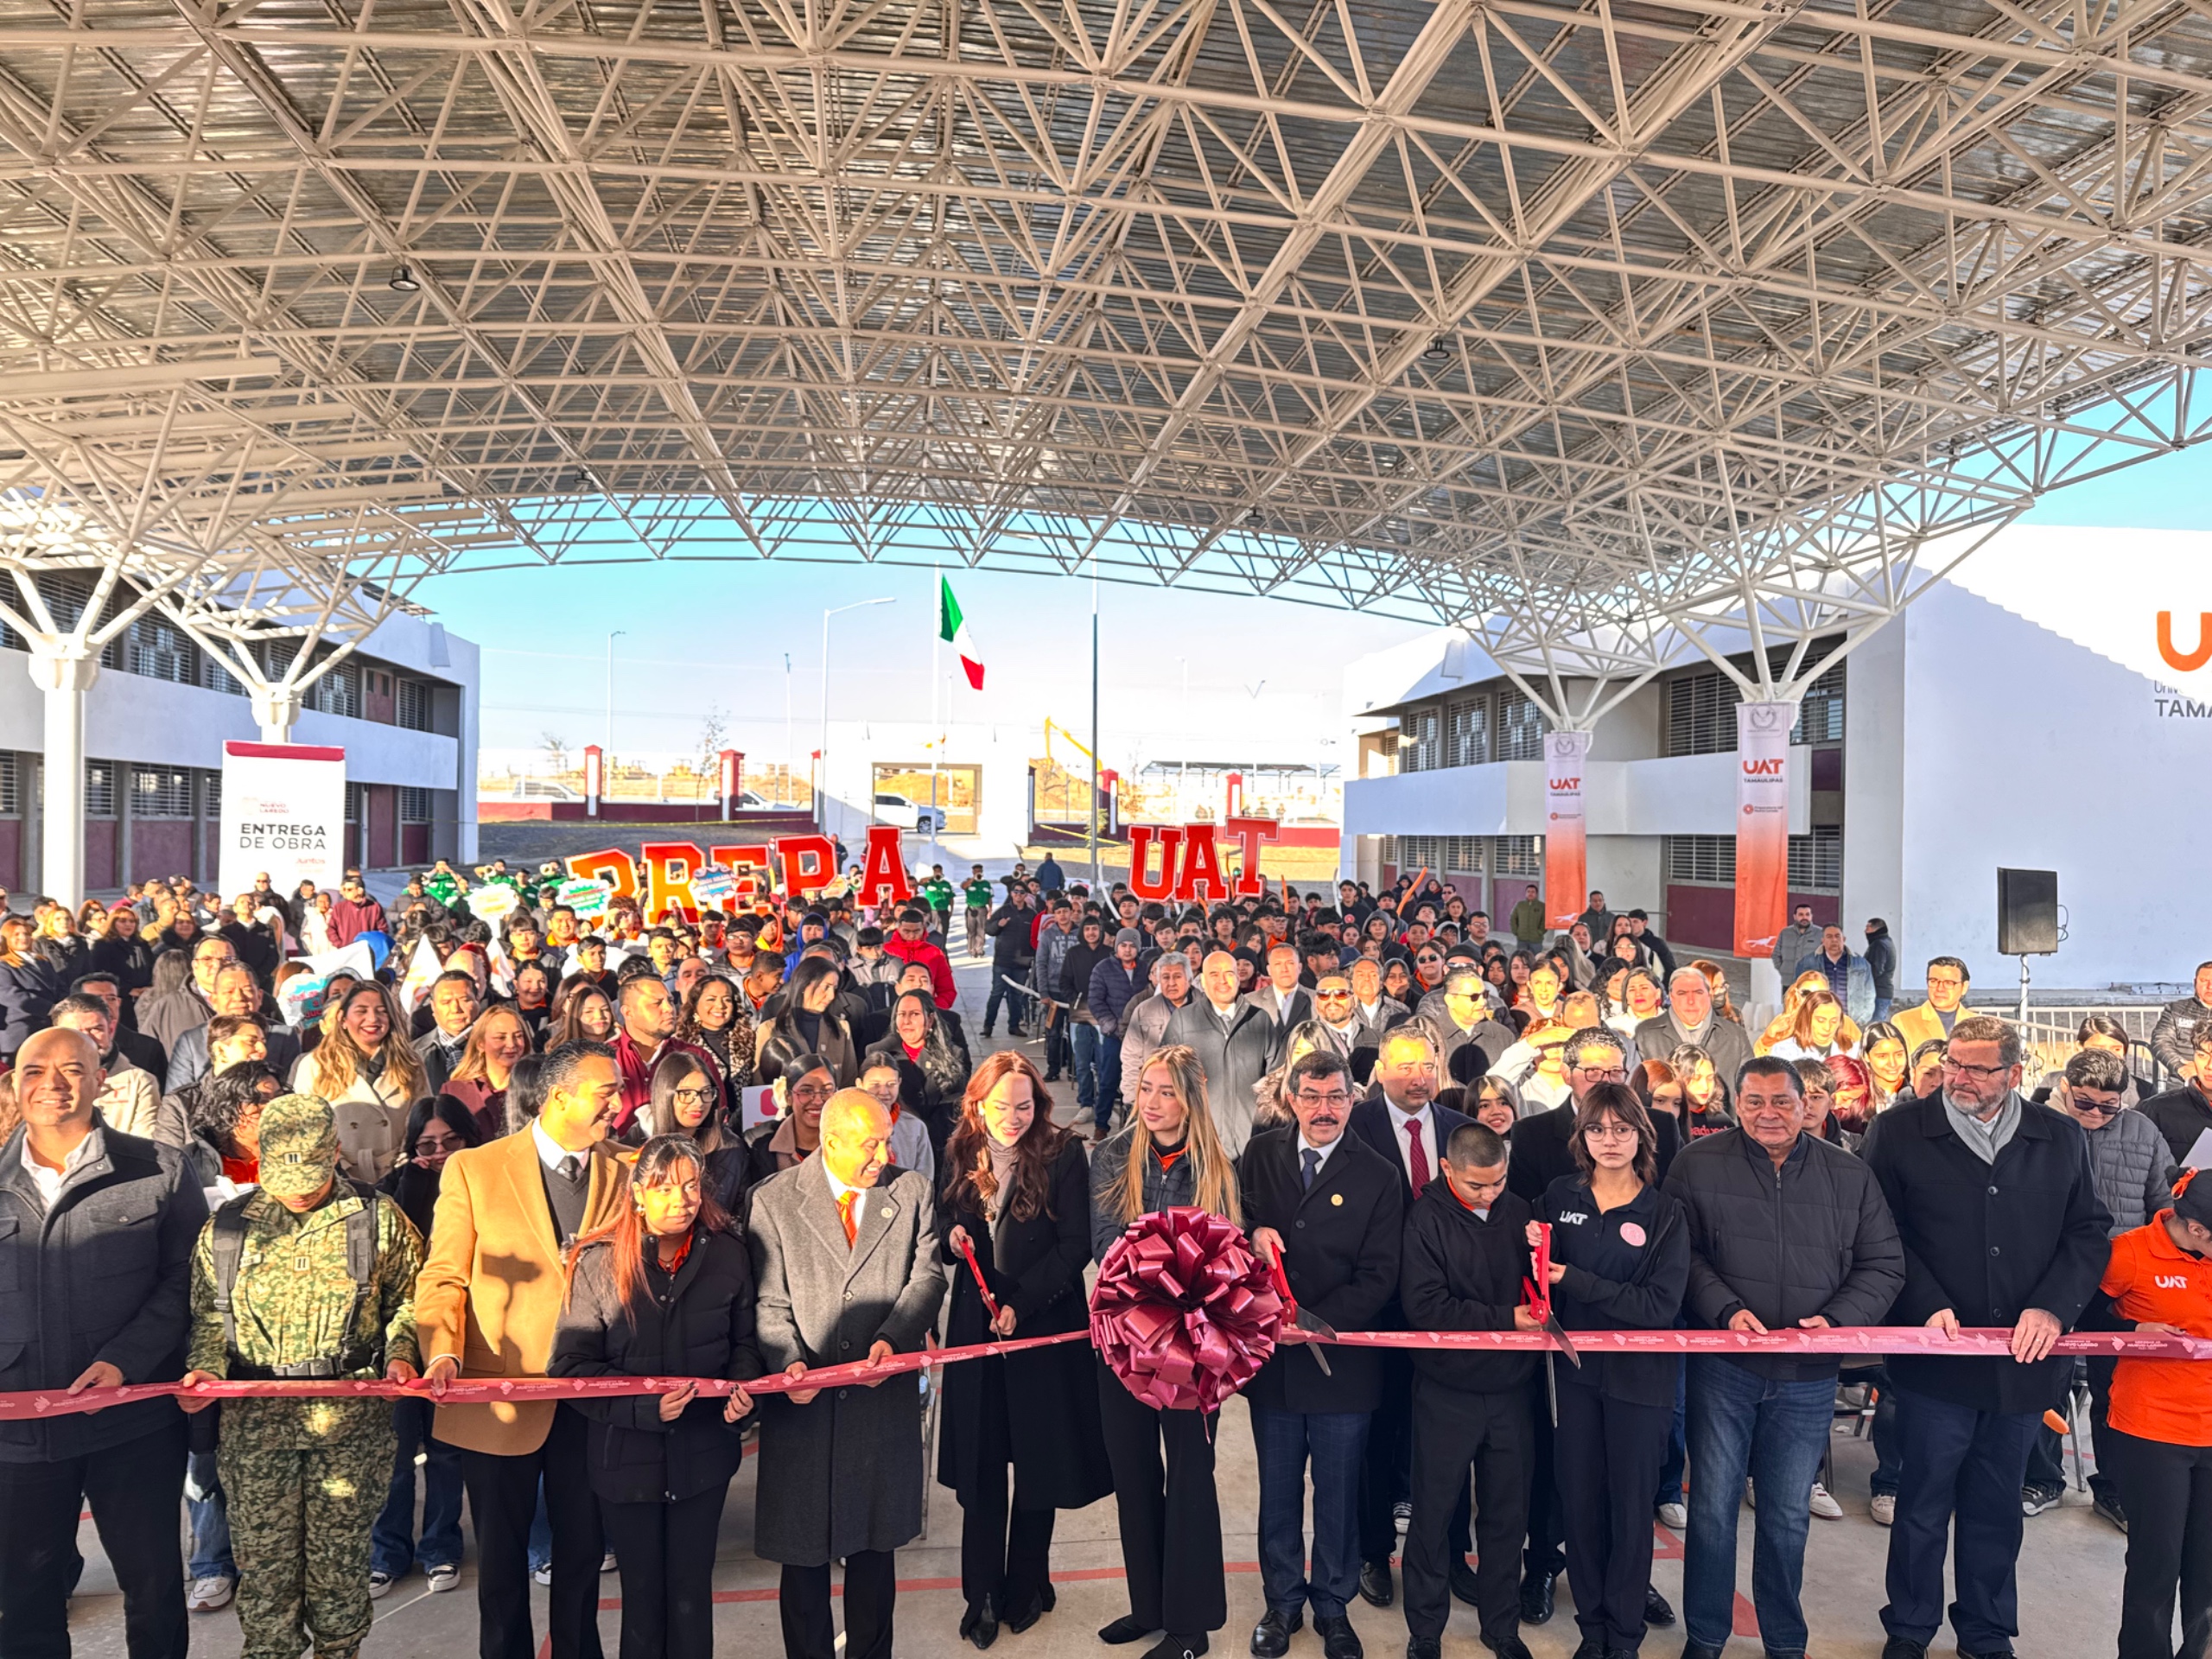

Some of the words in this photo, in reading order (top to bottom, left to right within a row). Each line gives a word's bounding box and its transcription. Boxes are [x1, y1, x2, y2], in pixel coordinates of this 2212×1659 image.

[1743, 759, 1783, 774] UAT
[1549, 778, 1580, 790] UAT
[241, 823, 326, 836] ENTREGA
[240, 836, 264, 849] DE
[272, 837, 326, 849] OBRA
[1128, 816, 1280, 903] UAT
[563, 825, 916, 930] PREPA
[1559, 1211, 1588, 1225] UAT
[2154, 1275, 2188, 1288] UAT
